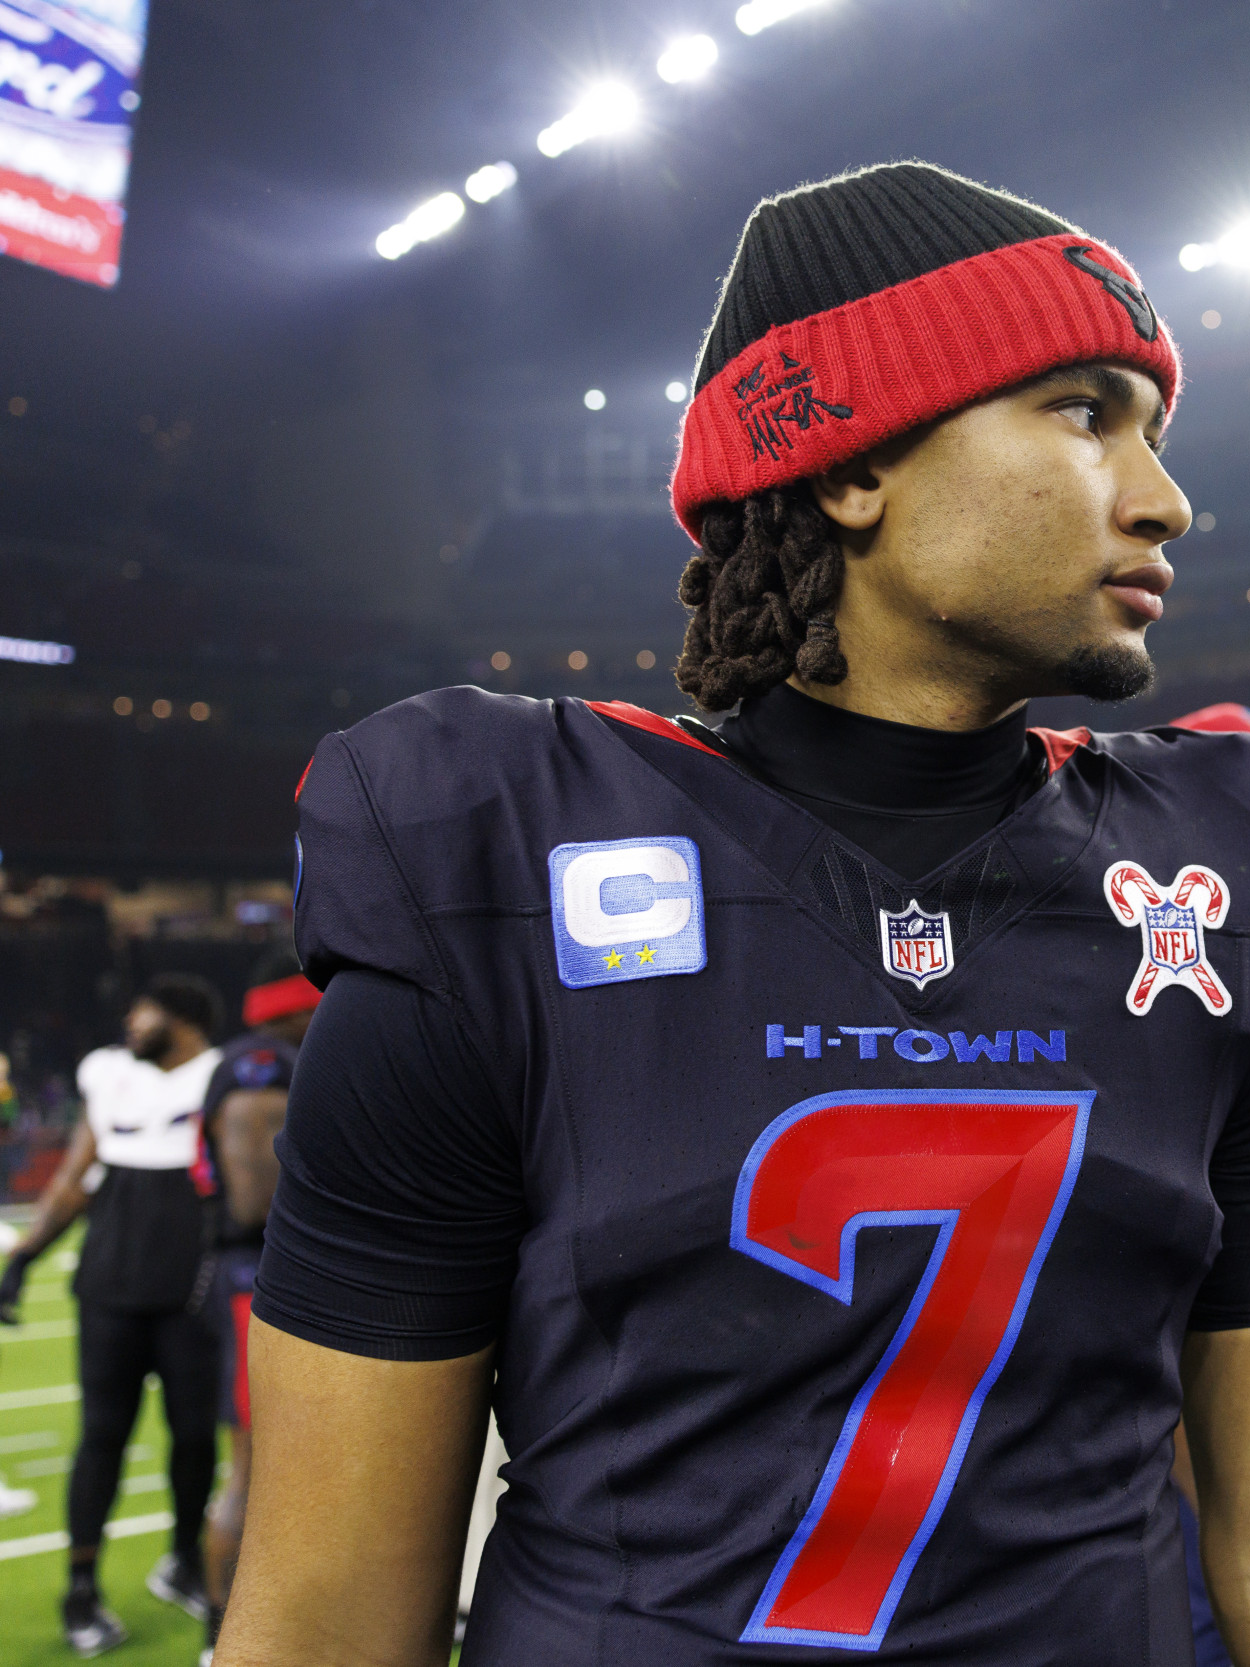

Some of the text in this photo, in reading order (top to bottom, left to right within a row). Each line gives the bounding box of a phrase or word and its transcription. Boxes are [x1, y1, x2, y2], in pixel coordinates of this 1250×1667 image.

[733, 361, 765, 401] BE
[738, 366, 815, 421] CHANGE
[562, 845, 692, 948] C
[894, 940, 943, 973] NFL
[1153, 930, 1195, 965] NFL
[766, 1024, 1067, 1063] H-TOWN
[729, 1088, 1098, 1652] 7
